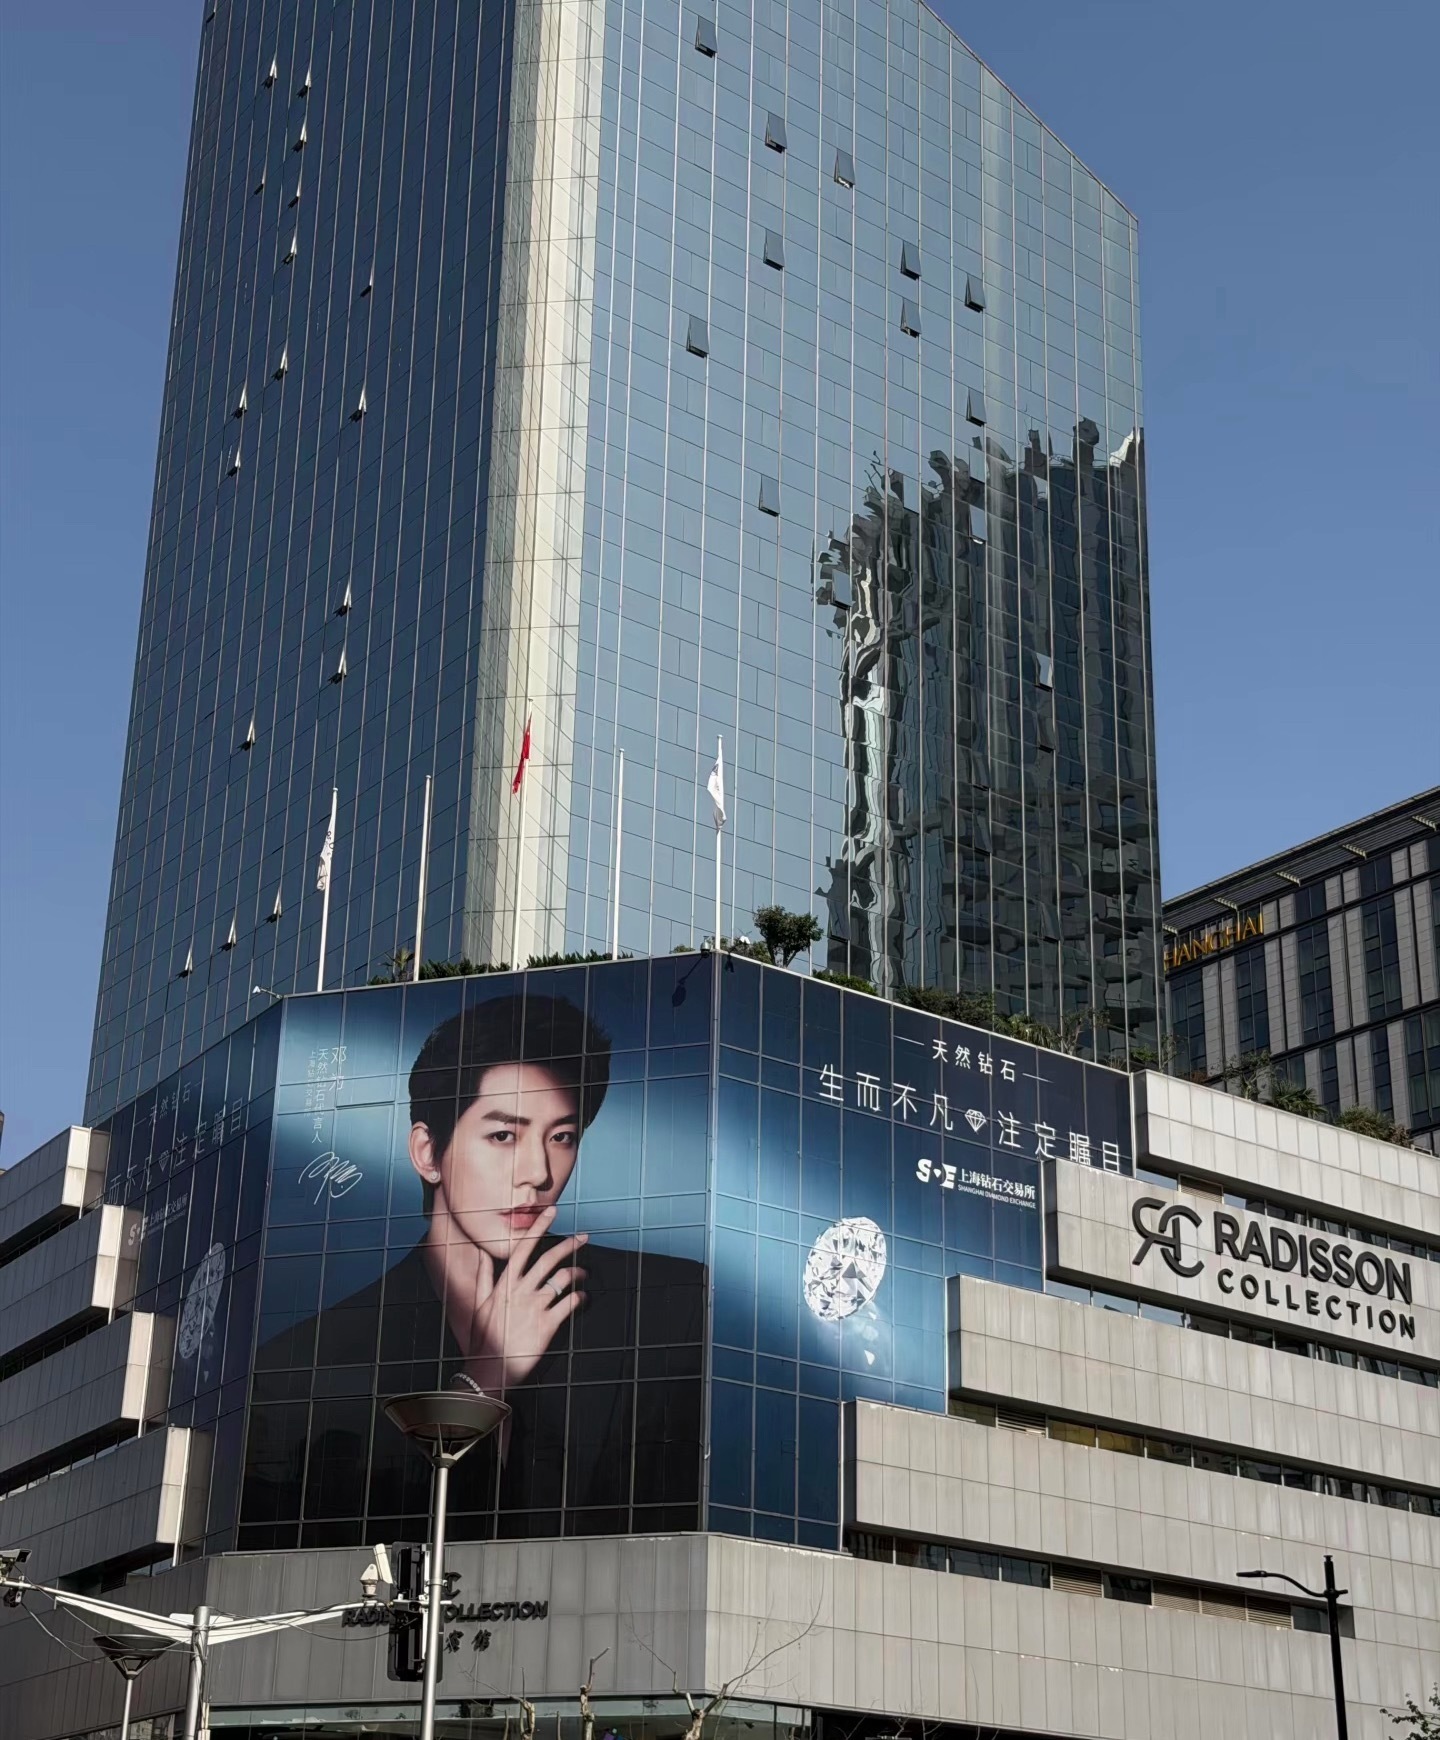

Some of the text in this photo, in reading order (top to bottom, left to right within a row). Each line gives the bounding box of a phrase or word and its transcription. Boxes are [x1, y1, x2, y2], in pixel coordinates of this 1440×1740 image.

[932, 1039, 1016, 1083] 天然钻石
[817, 1064, 953, 1131] 生而不凡
[958, 1168, 1036, 1200] 上海钻石交易所
[958, 1185, 984, 1197] SHANGHAI
[1009, 1196, 1037, 1209] EXCHANGE
[1213, 1211, 1412, 1305] RADISSON
[1217, 1268, 1416, 1340] COLLECTION
[443, 1600, 549, 1623] OLLECTION
